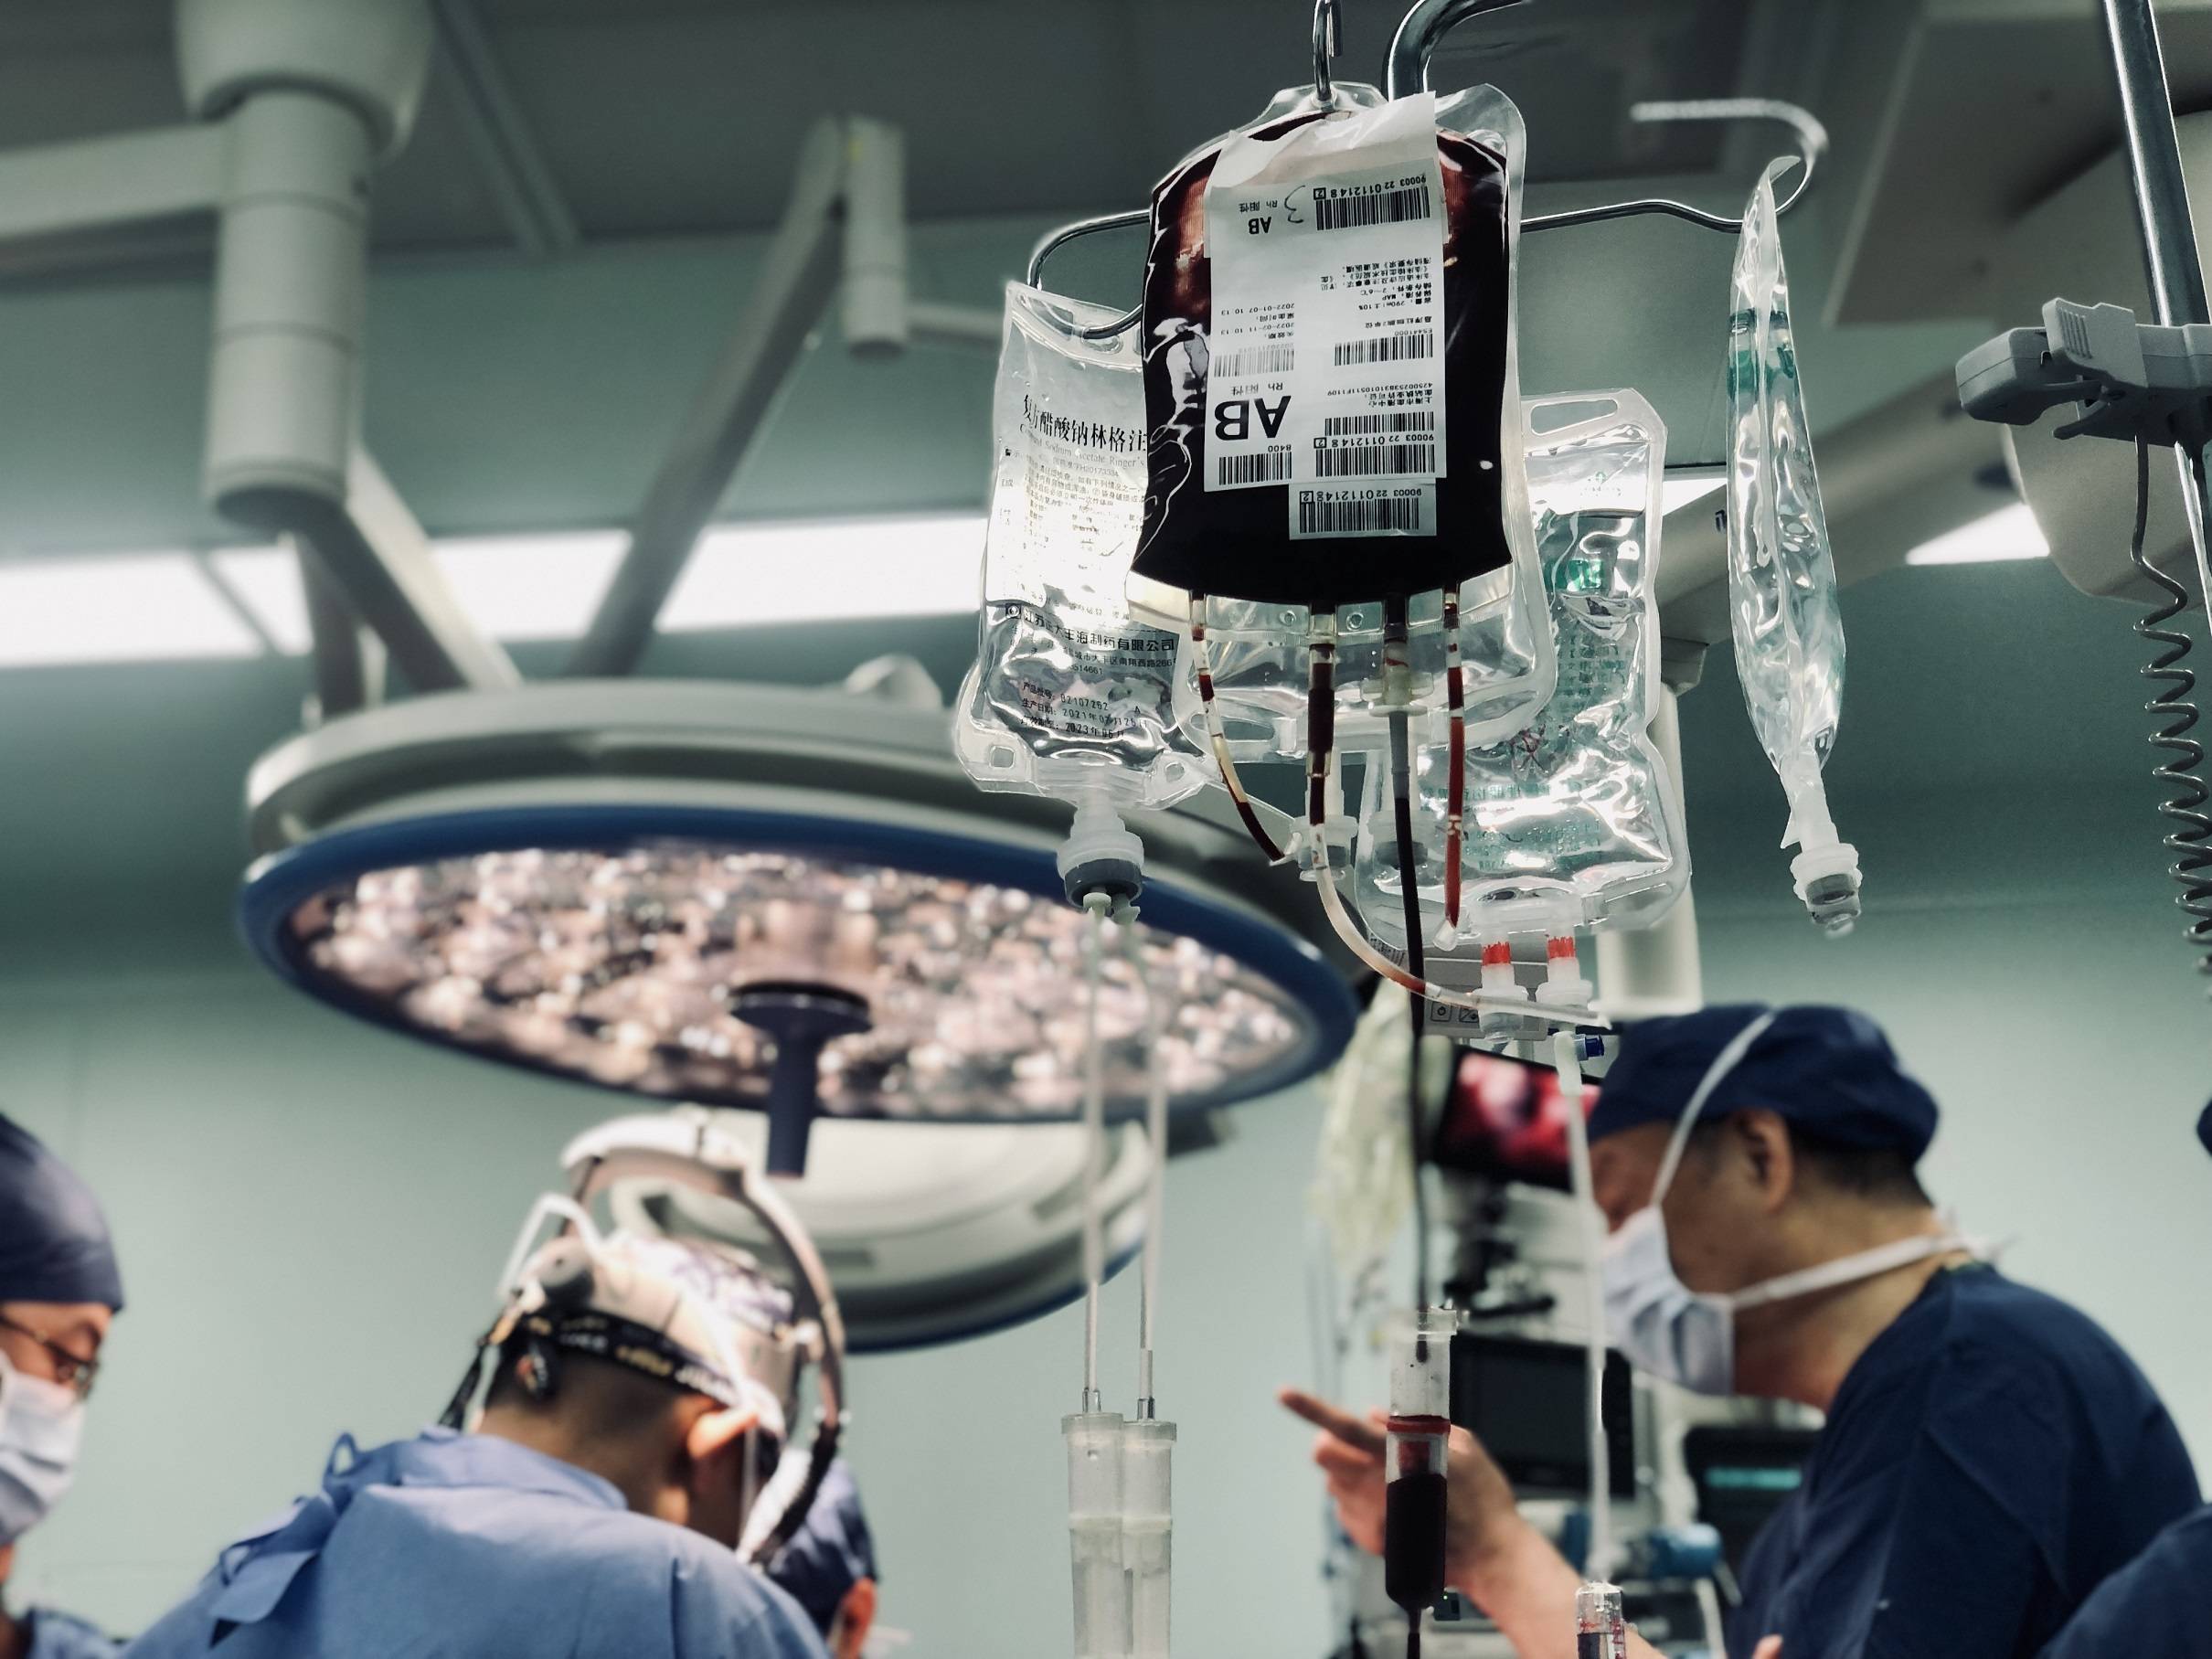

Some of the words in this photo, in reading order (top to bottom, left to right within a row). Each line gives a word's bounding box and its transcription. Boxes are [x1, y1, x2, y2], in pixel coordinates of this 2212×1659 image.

[1238, 201, 1260, 212] 阳性
[1266, 200, 1278, 208] Rh
[1249, 217, 1271, 234] AB
[1268, 382, 1283, 391] Rh
[1214, 395, 1291, 441] AB
[1268, 444, 1292, 452] 8400
[1393, 489, 1421, 497] 90003
